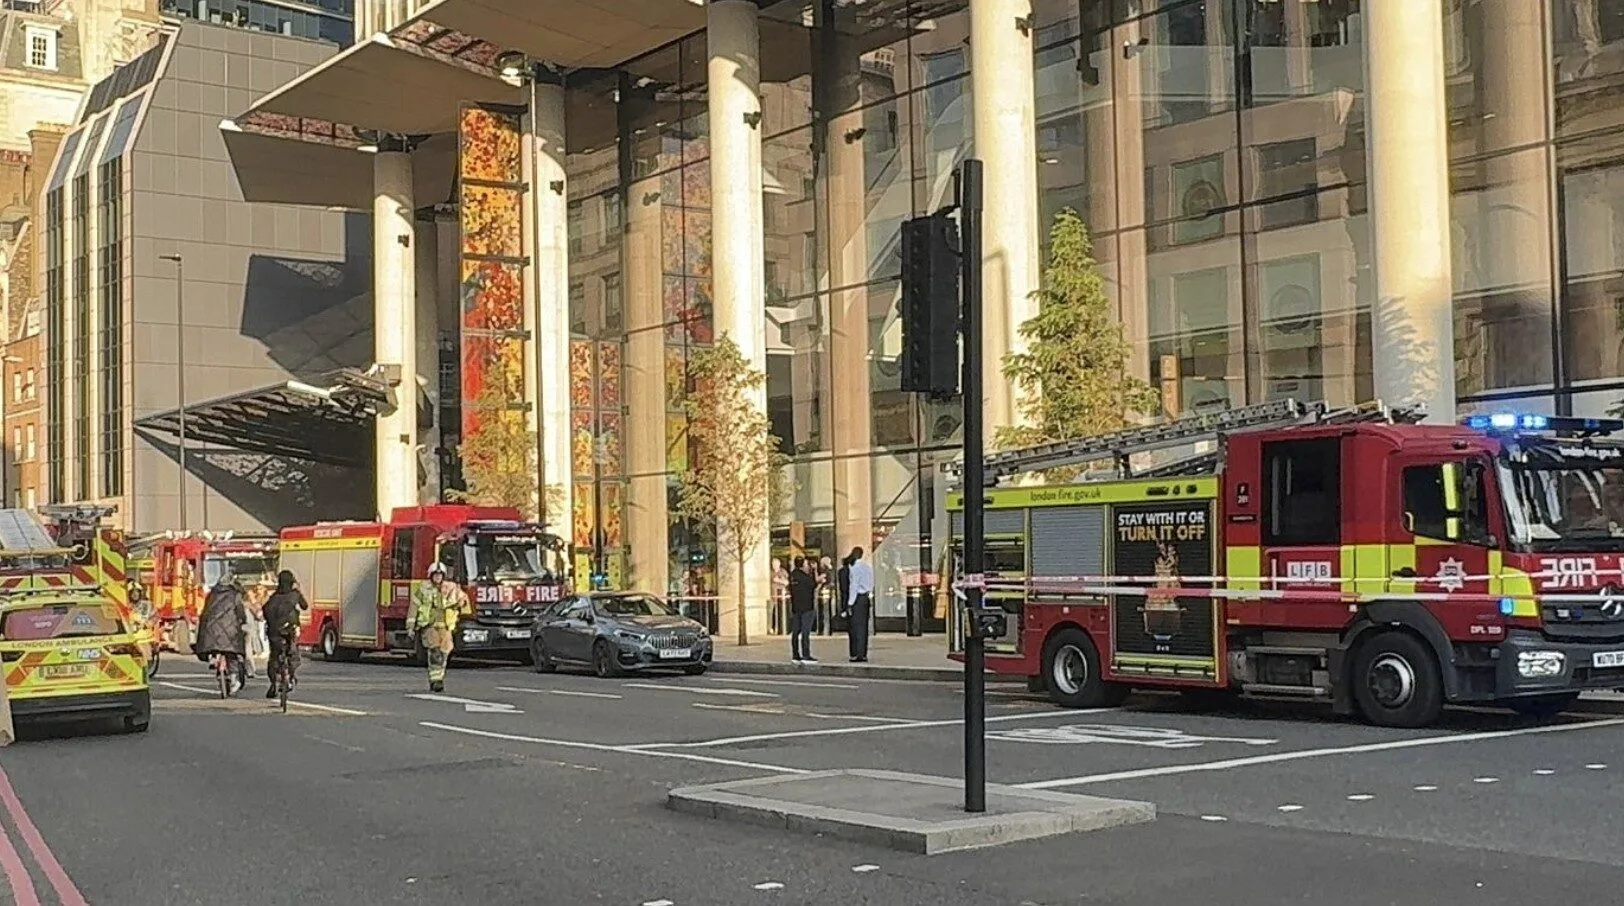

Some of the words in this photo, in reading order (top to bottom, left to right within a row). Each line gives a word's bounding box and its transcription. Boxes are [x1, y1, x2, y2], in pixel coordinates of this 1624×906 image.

[1118, 513, 1144, 526] STAY
[1145, 512, 1174, 525] WITH
[1176, 511, 1187, 524] IT
[1188, 511, 1205, 523] OR
[1118, 525, 1156, 541] TURN
[1160, 525, 1174, 541] IT
[1177, 525, 1205, 540] OFF
[1291, 564, 1328, 577] LFB
[526, 586, 559, 602] FIRE
[12, 641, 53, 649] LONDON
[56, 636, 113, 647] AMBULANCE
